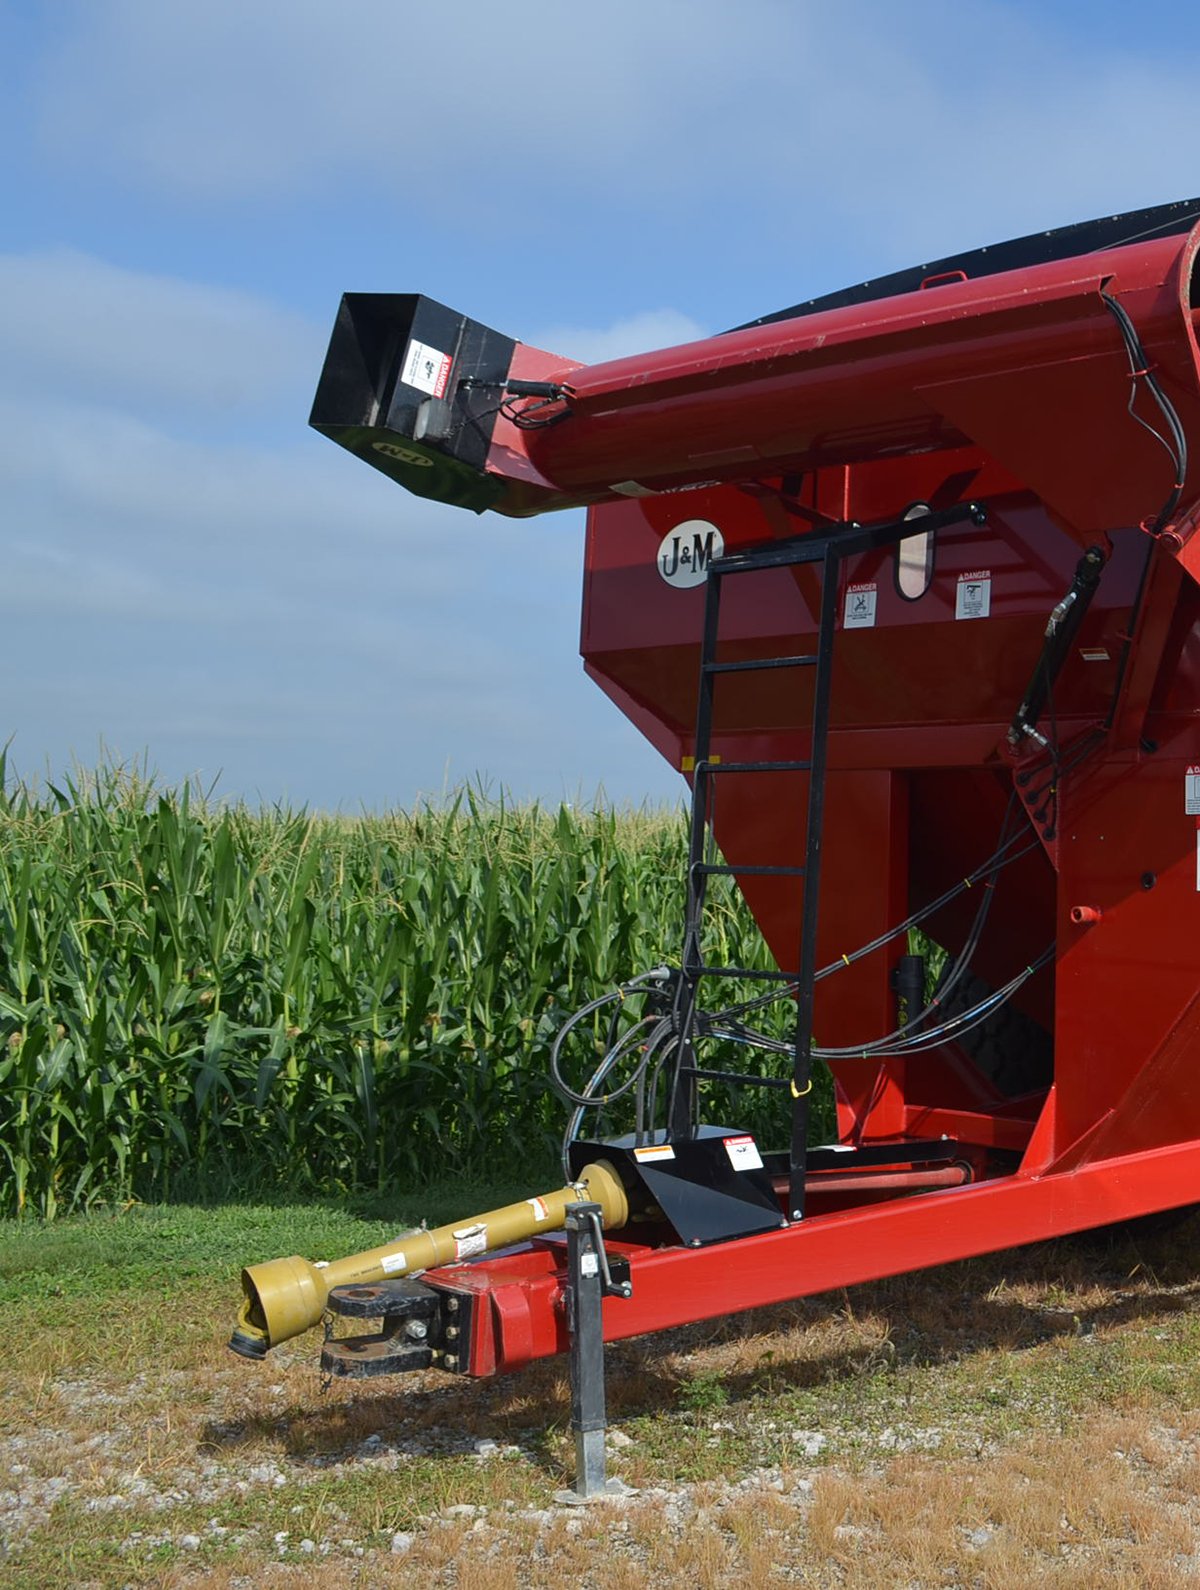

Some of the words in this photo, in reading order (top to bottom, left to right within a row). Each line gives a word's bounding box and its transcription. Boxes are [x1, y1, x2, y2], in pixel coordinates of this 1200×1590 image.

[662, 530, 715, 577] J&M
[964, 570, 991, 580] DANGER
[852, 583, 877, 592] DANGER
